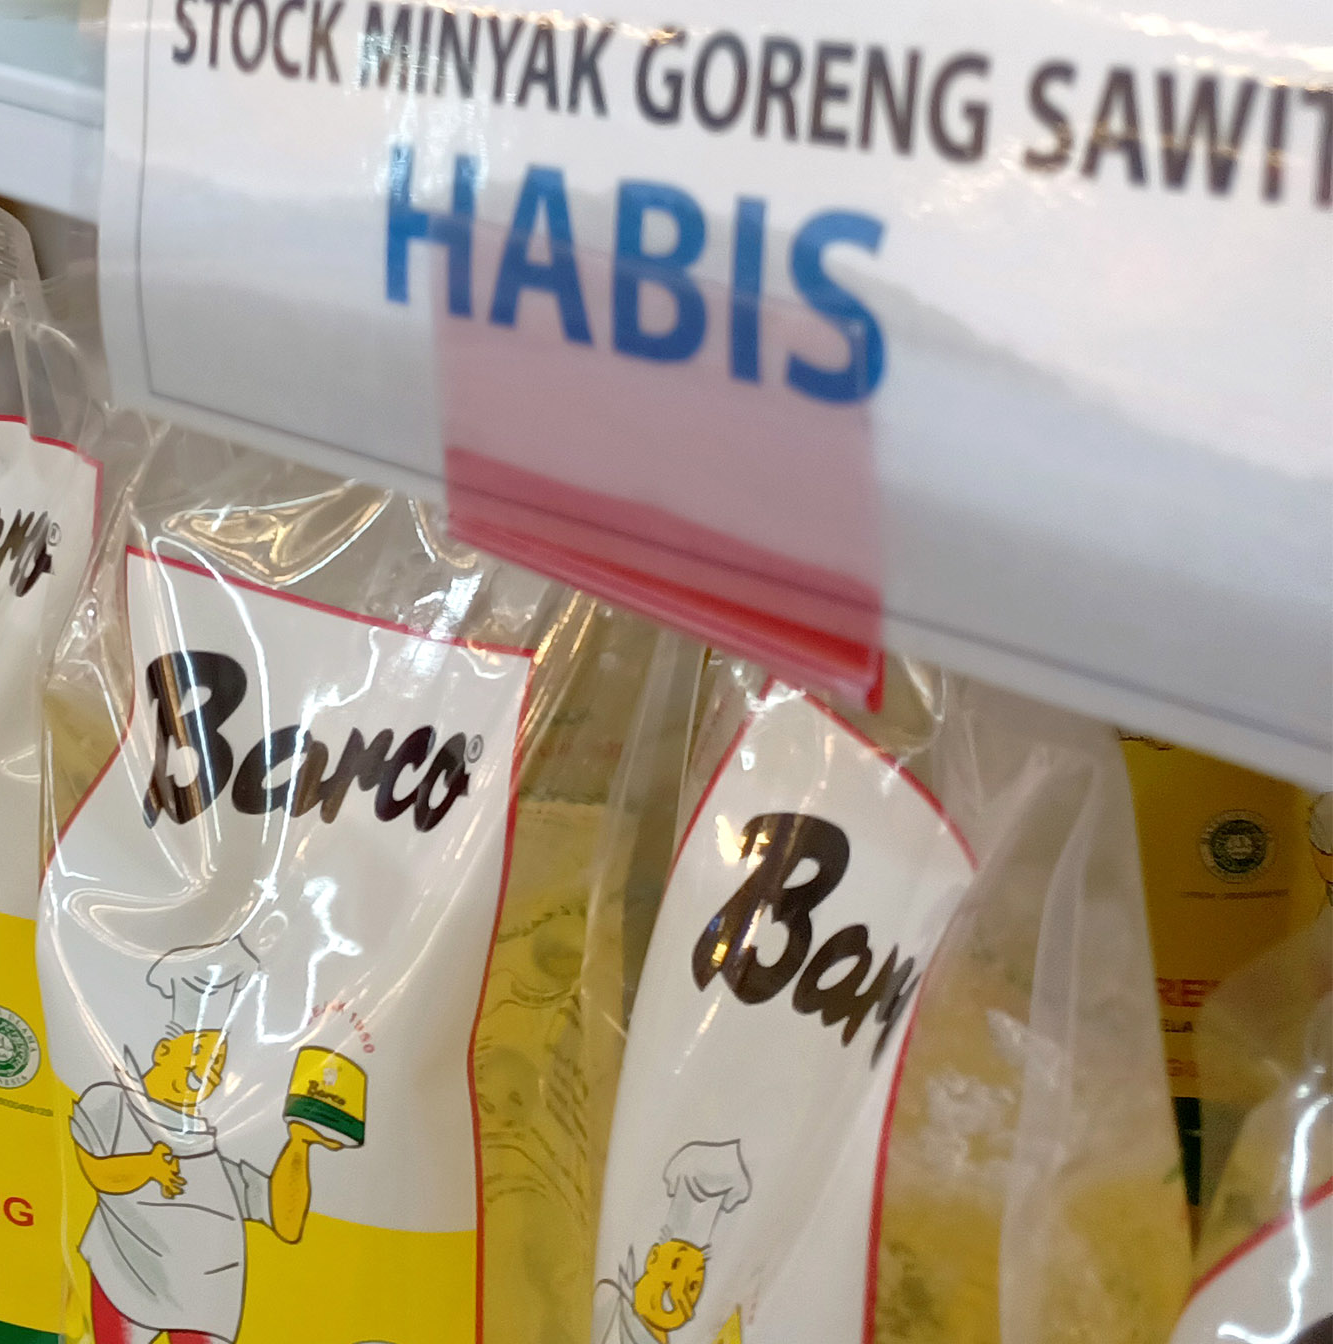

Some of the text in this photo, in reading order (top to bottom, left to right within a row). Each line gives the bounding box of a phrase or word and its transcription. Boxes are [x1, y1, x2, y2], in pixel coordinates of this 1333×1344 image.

[361, 0, 617, 119] MINYAK
[634, 24, 989, 164] GORENG
[383, 141, 889, 406] HABIS
[141, 649, 472, 833] Barco
[690, 810, 921, 1071] Bar
